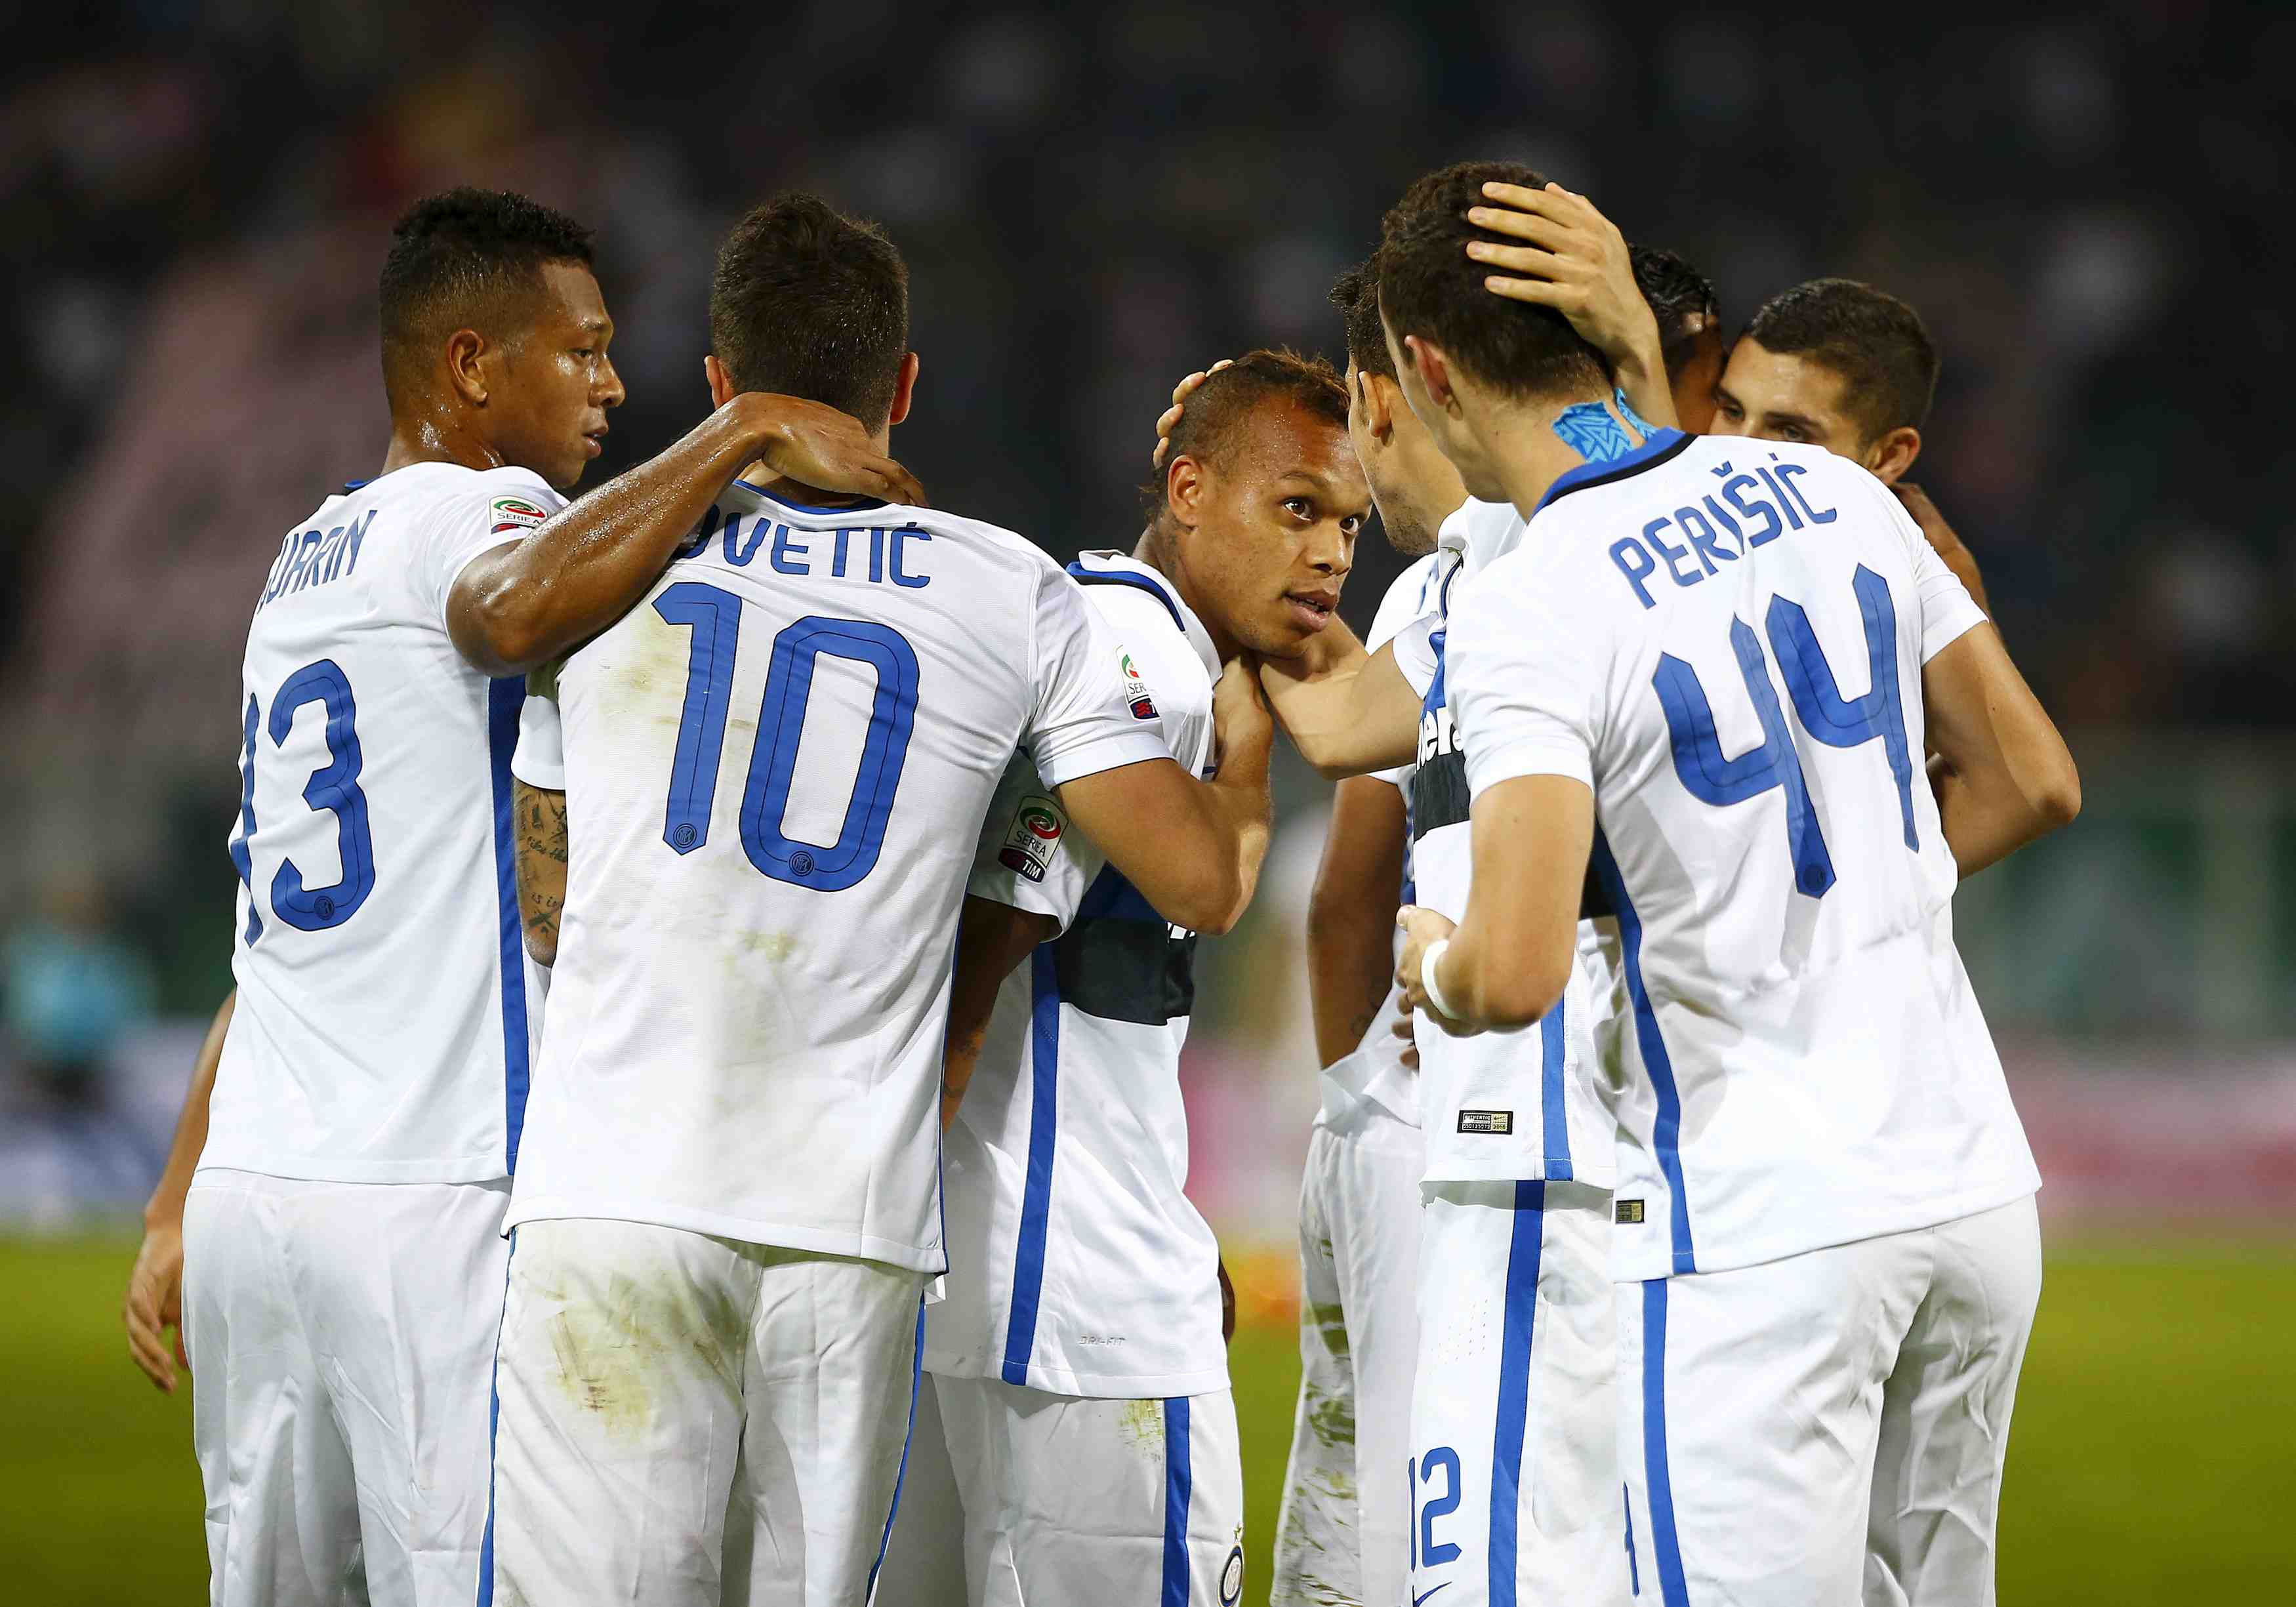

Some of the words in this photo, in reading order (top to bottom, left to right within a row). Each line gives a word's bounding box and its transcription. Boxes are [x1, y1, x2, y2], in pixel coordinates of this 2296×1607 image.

[256, 509, 379, 615] UARIN
[1609, 452, 1837, 609] PERIŠIĆ
[651, 581, 920, 893] 10
[1128, 681, 1147, 695] SER
[1652, 562, 1919, 899] 44
[1022, 859, 1042, 879] TIM
